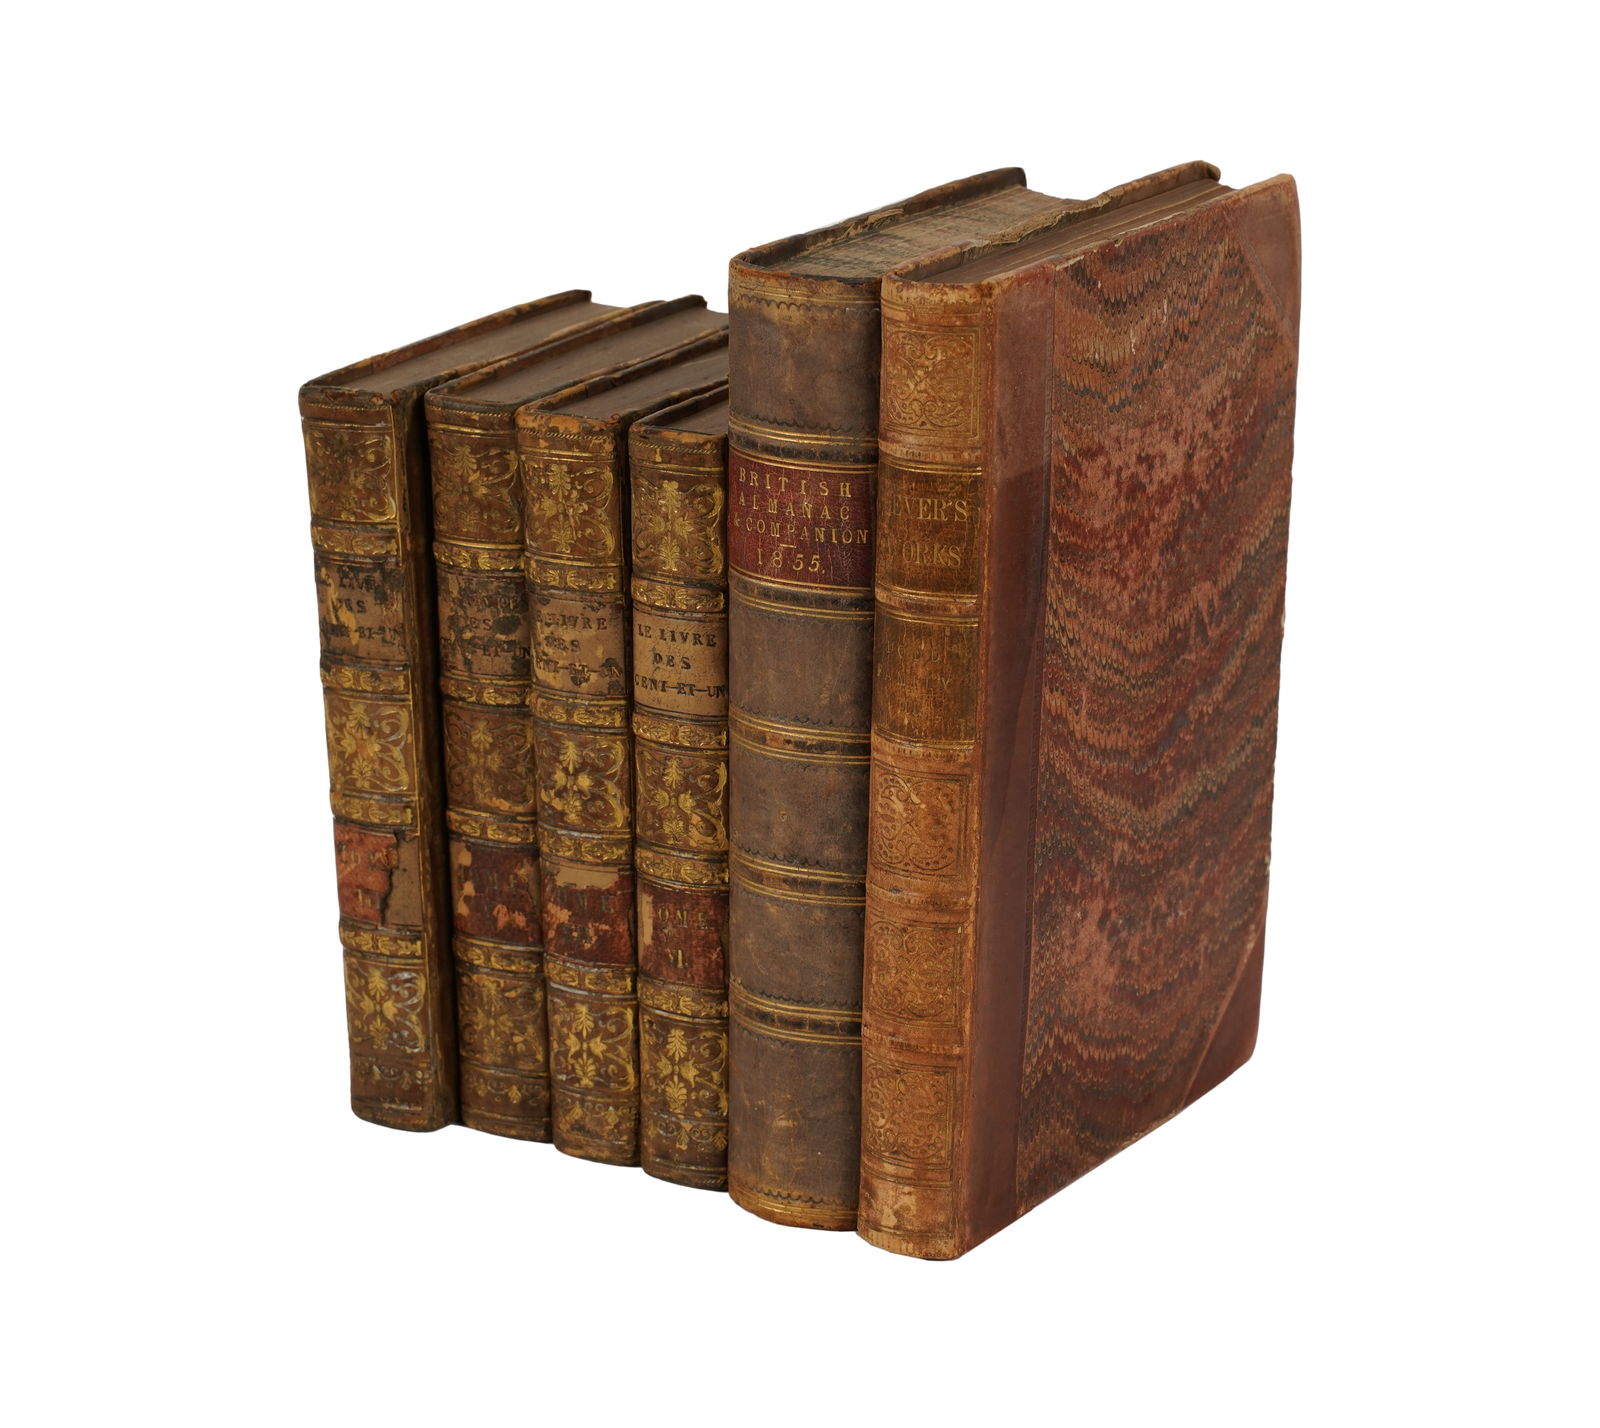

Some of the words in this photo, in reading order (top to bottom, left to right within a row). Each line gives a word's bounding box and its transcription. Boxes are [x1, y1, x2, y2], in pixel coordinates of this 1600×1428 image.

[739, 467, 851, 498] BRITISH
[739, 491, 850, 520] ALMANAC
[885, 494, 968, 521] EVER'S
[757, 548, 826, 575] 1855.
[637, 623, 652, 639] LE
[659, 628, 717, 647] LIVRE
[652, 652, 692, 670] DES
